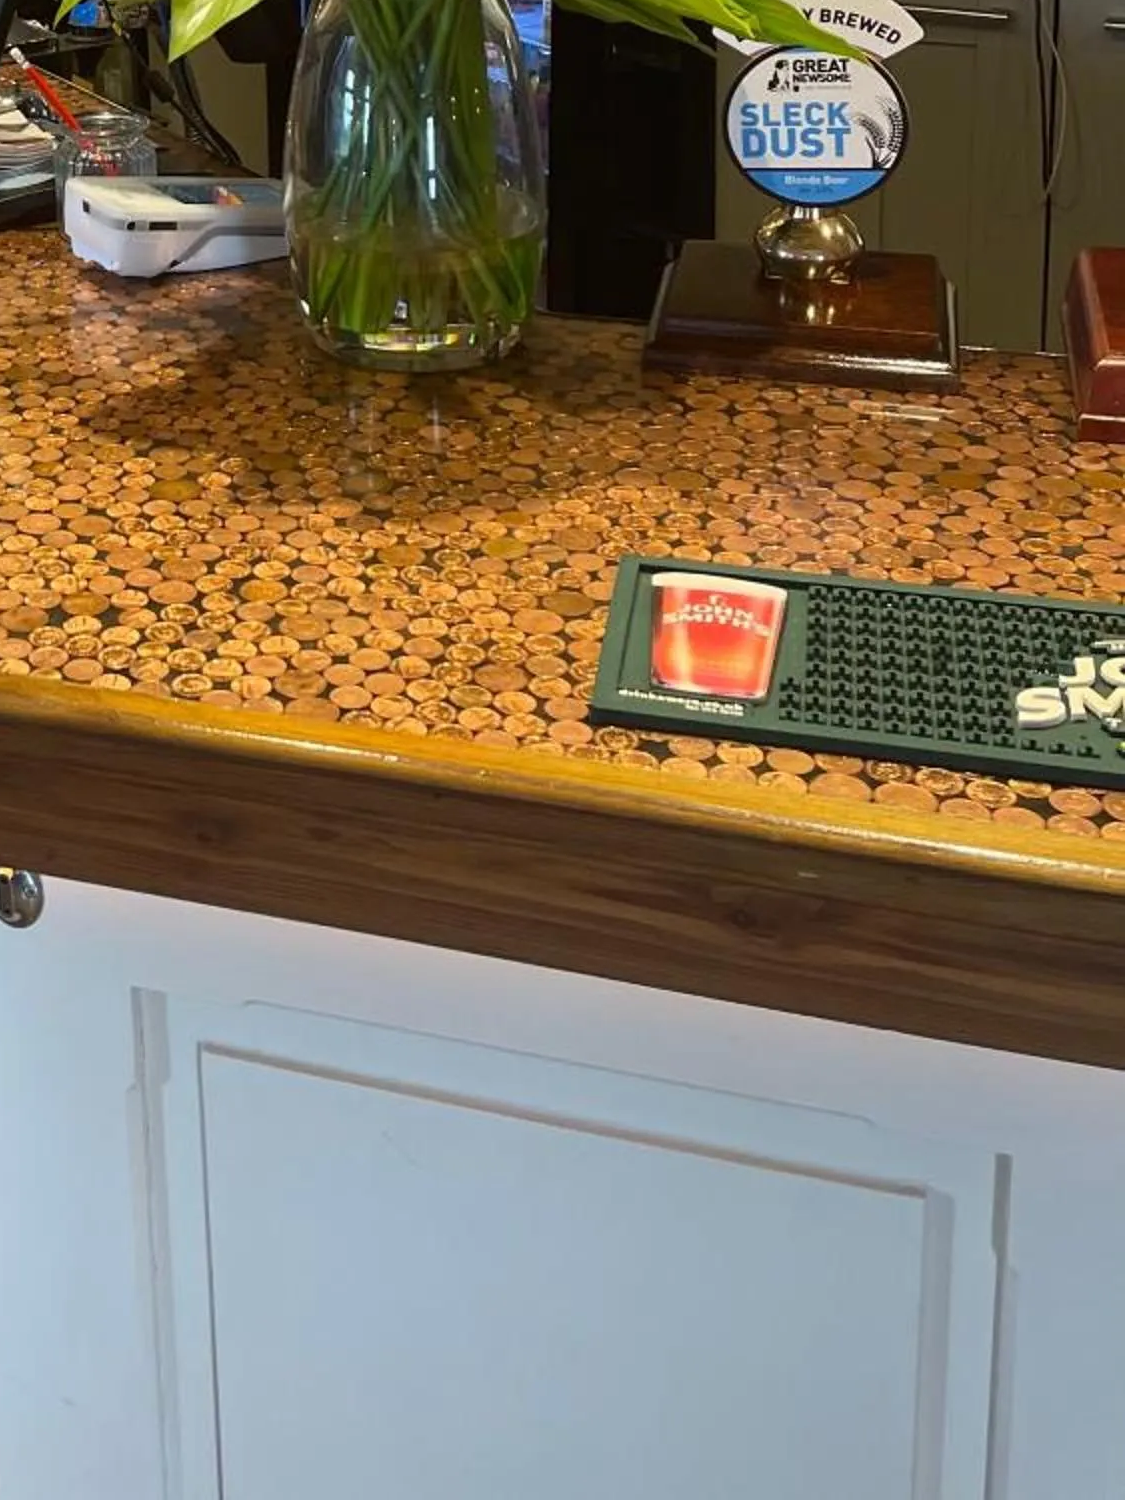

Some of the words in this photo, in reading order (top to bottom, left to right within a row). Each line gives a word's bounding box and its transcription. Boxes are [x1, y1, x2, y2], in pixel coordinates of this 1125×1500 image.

[819, 8, 902, 46] BREWED
[792, 58, 851, 73] GREAT
[792, 73, 852, 83] NEWSOME
[739, 101, 852, 127] SLECK
[742, 127, 852, 159] DUST
[683, 603, 754, 622] JOHN
